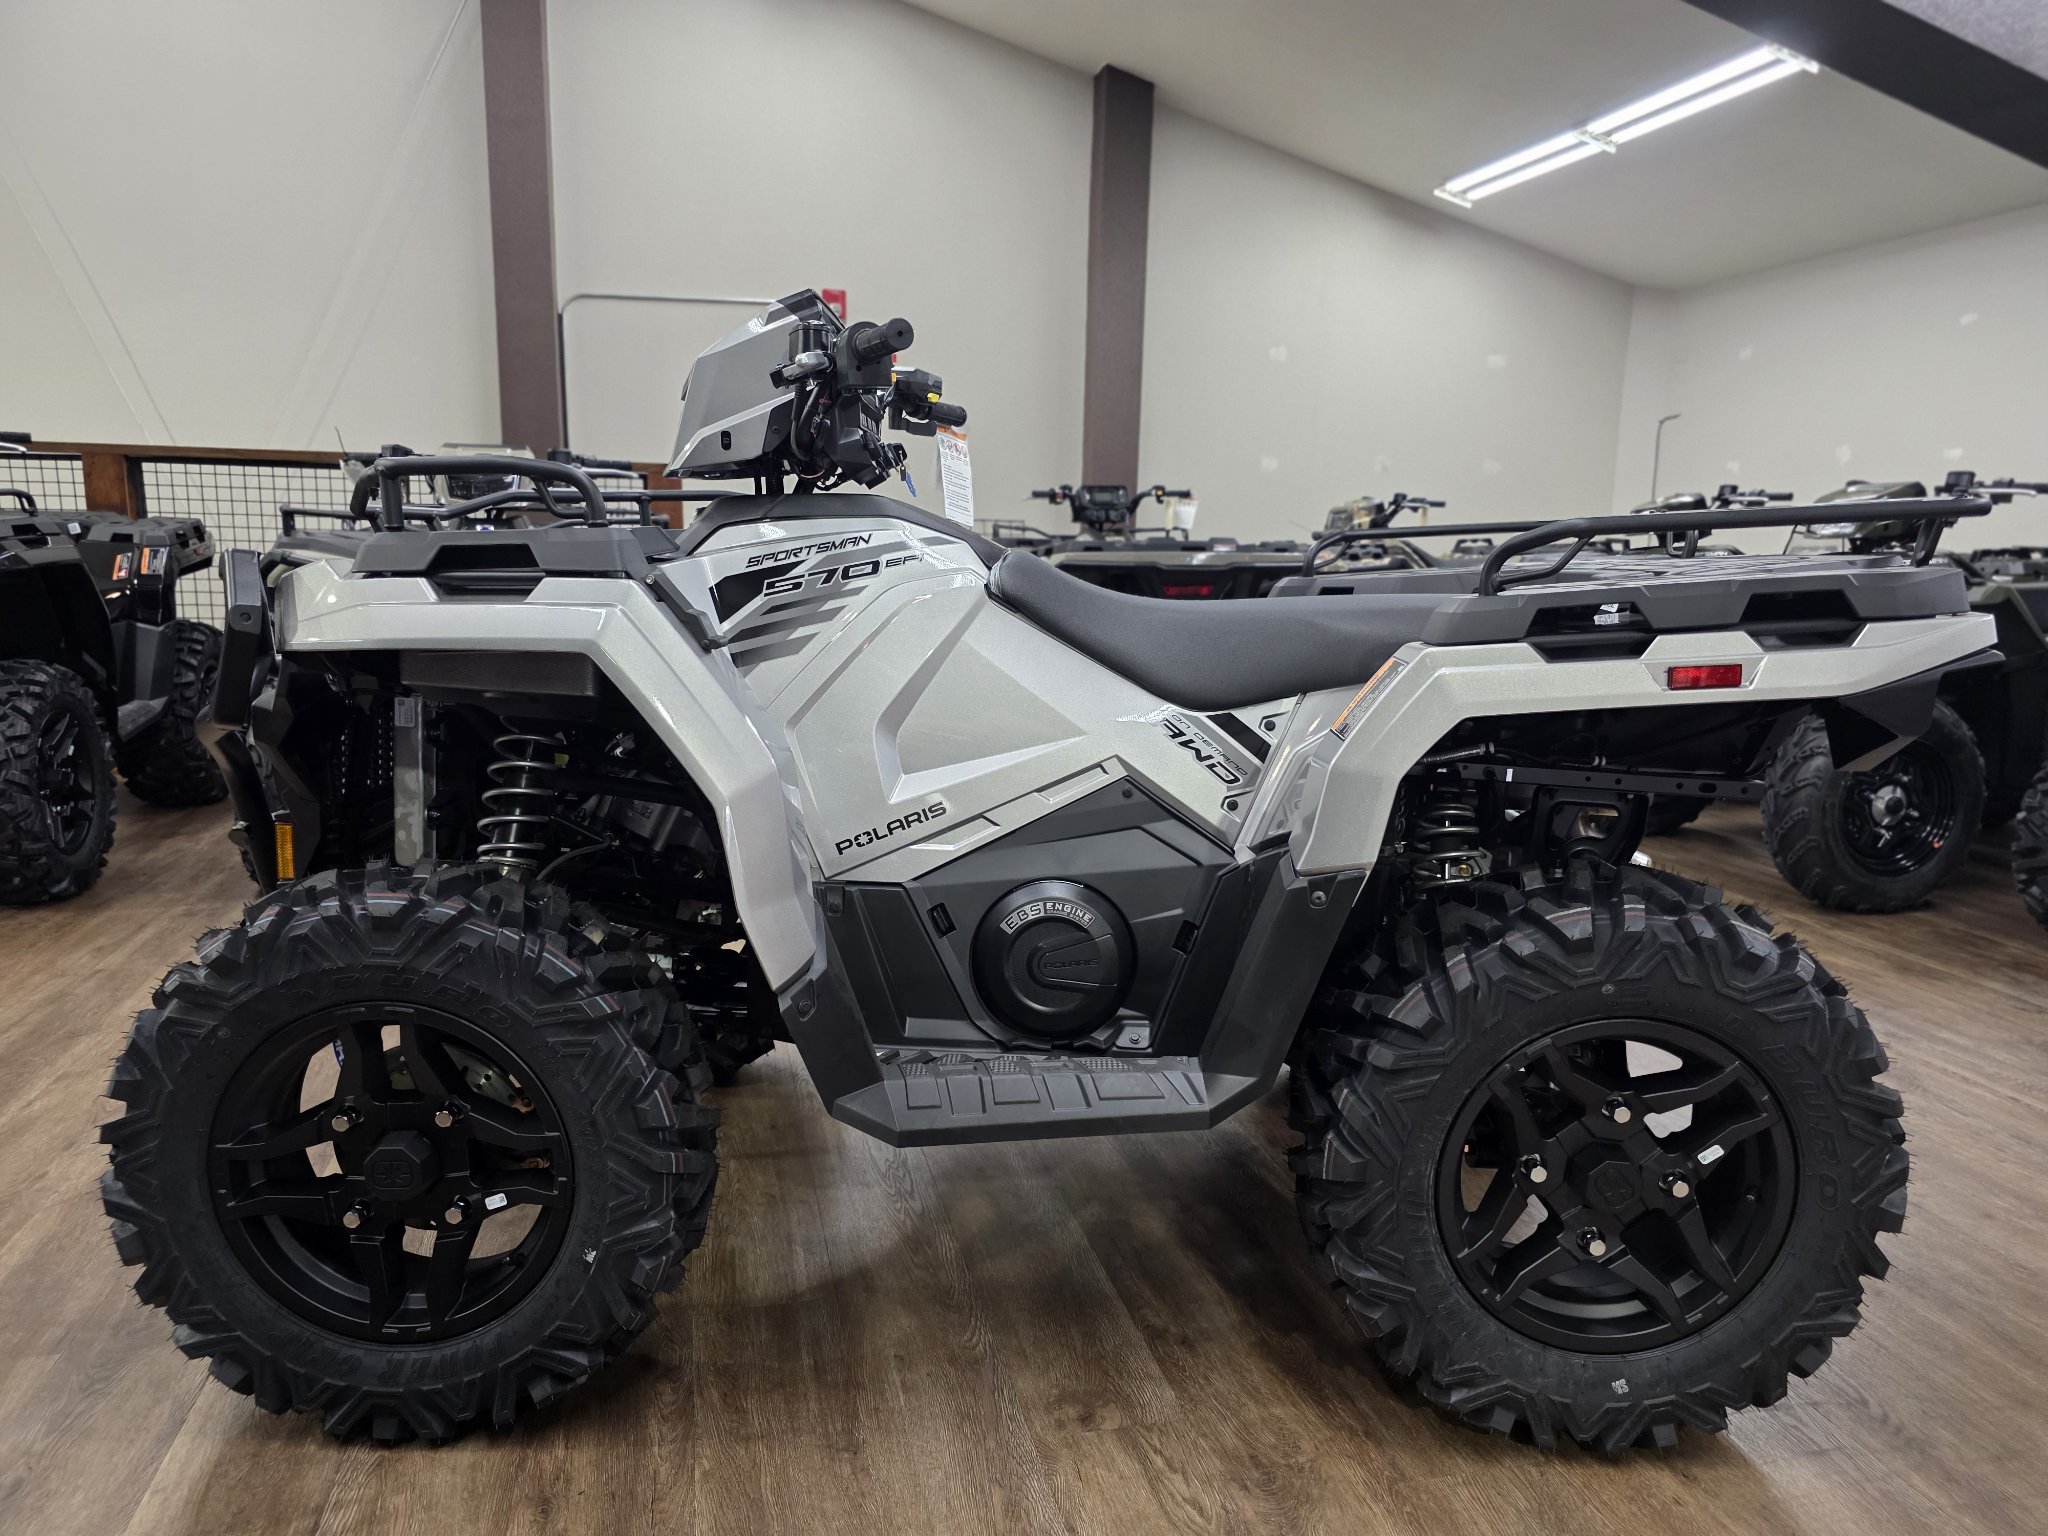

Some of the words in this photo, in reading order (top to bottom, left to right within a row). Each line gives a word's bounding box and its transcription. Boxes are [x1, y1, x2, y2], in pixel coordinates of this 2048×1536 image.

[745, 533, 873, 569] SPORTSMAN
[763, 558, 881, 598] 570
[1162, 717, 1241, 785] AWD
[835, 801, 947, 856] POLARIS
[1005, 903, 1042, 930] EBS
[1046, 903, 1092, 923] ENGINE
[1043, 958, 1100, 970] POLARIS
[1758, 1043, 1842, 1212] DURO
